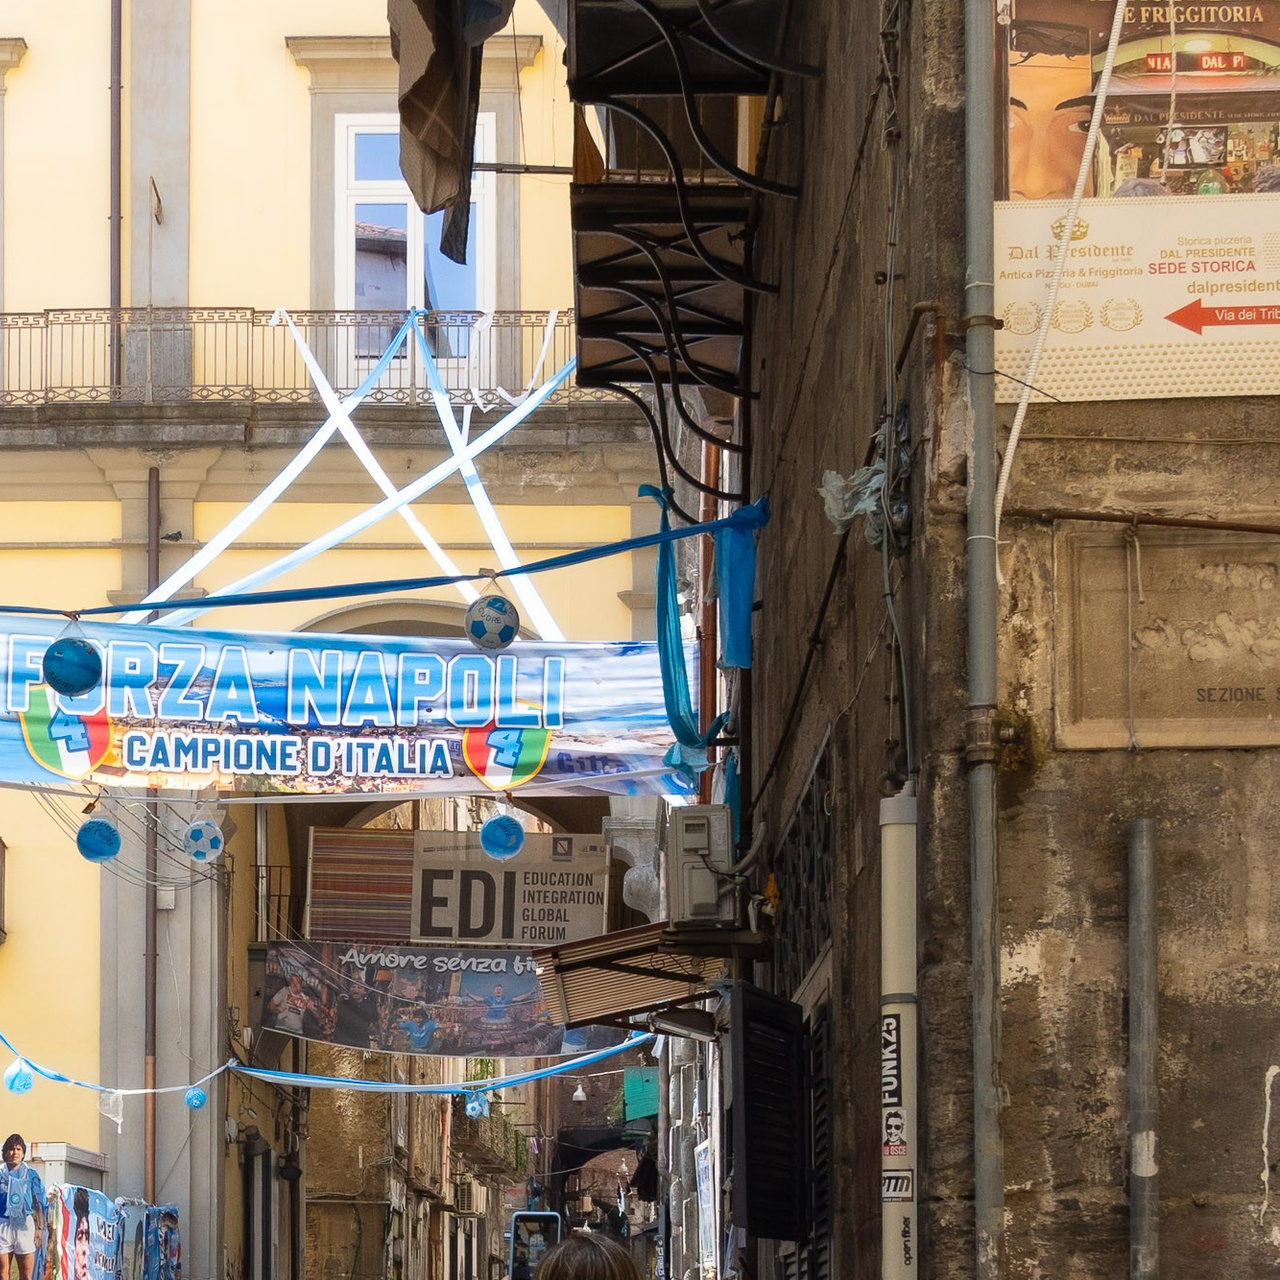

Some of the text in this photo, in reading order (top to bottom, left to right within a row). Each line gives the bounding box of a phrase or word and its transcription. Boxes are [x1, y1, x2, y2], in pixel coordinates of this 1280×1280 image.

[1141, 6, 1264, 24] FRIGGITORIA
[1202, 56, 1226, 69] DAL
[1133, 113, 1157, 123] DAL
[1177, 235, 1252, 248] Storica pizzeria
[1007, 244, 1134, 261] Dal Pesidente
[1160, 247, 1255, 259] DAL PRESIDENTE
[999, 265, 1144, 280] Antica Pizzria & Friggitoria
[1148, 260, 1256, 275] SEDE STORICA
[1215, 310, 1235, 321] Via
[1238, 308, 1256, 320] dei
[288, 647, 566, 730] NAPOLI
[1196, 687, 1266, 703] SEZIONE
[49, 712, 90, 753] 4
[122, 731, 302, 778] CAMPIONE
[310, 736, 456, 779] D'ITALIA
[486, 726, 524, 769] 4
[523, 871, 594, 888] EDUCATION
[419, 869, 517, 940] EDI
[522, 890, 605, 906] INTEGRATION
[521, 907, 570, 923] GLOBAL
[521, 926, 567, 941] FORUM
[338, 948, 428, 972] Amore
[432, 954, 508, 974] senza
[880, 1016, 899, 1105] FUNK25
[901, 1216, 913, 1266] open fiber
